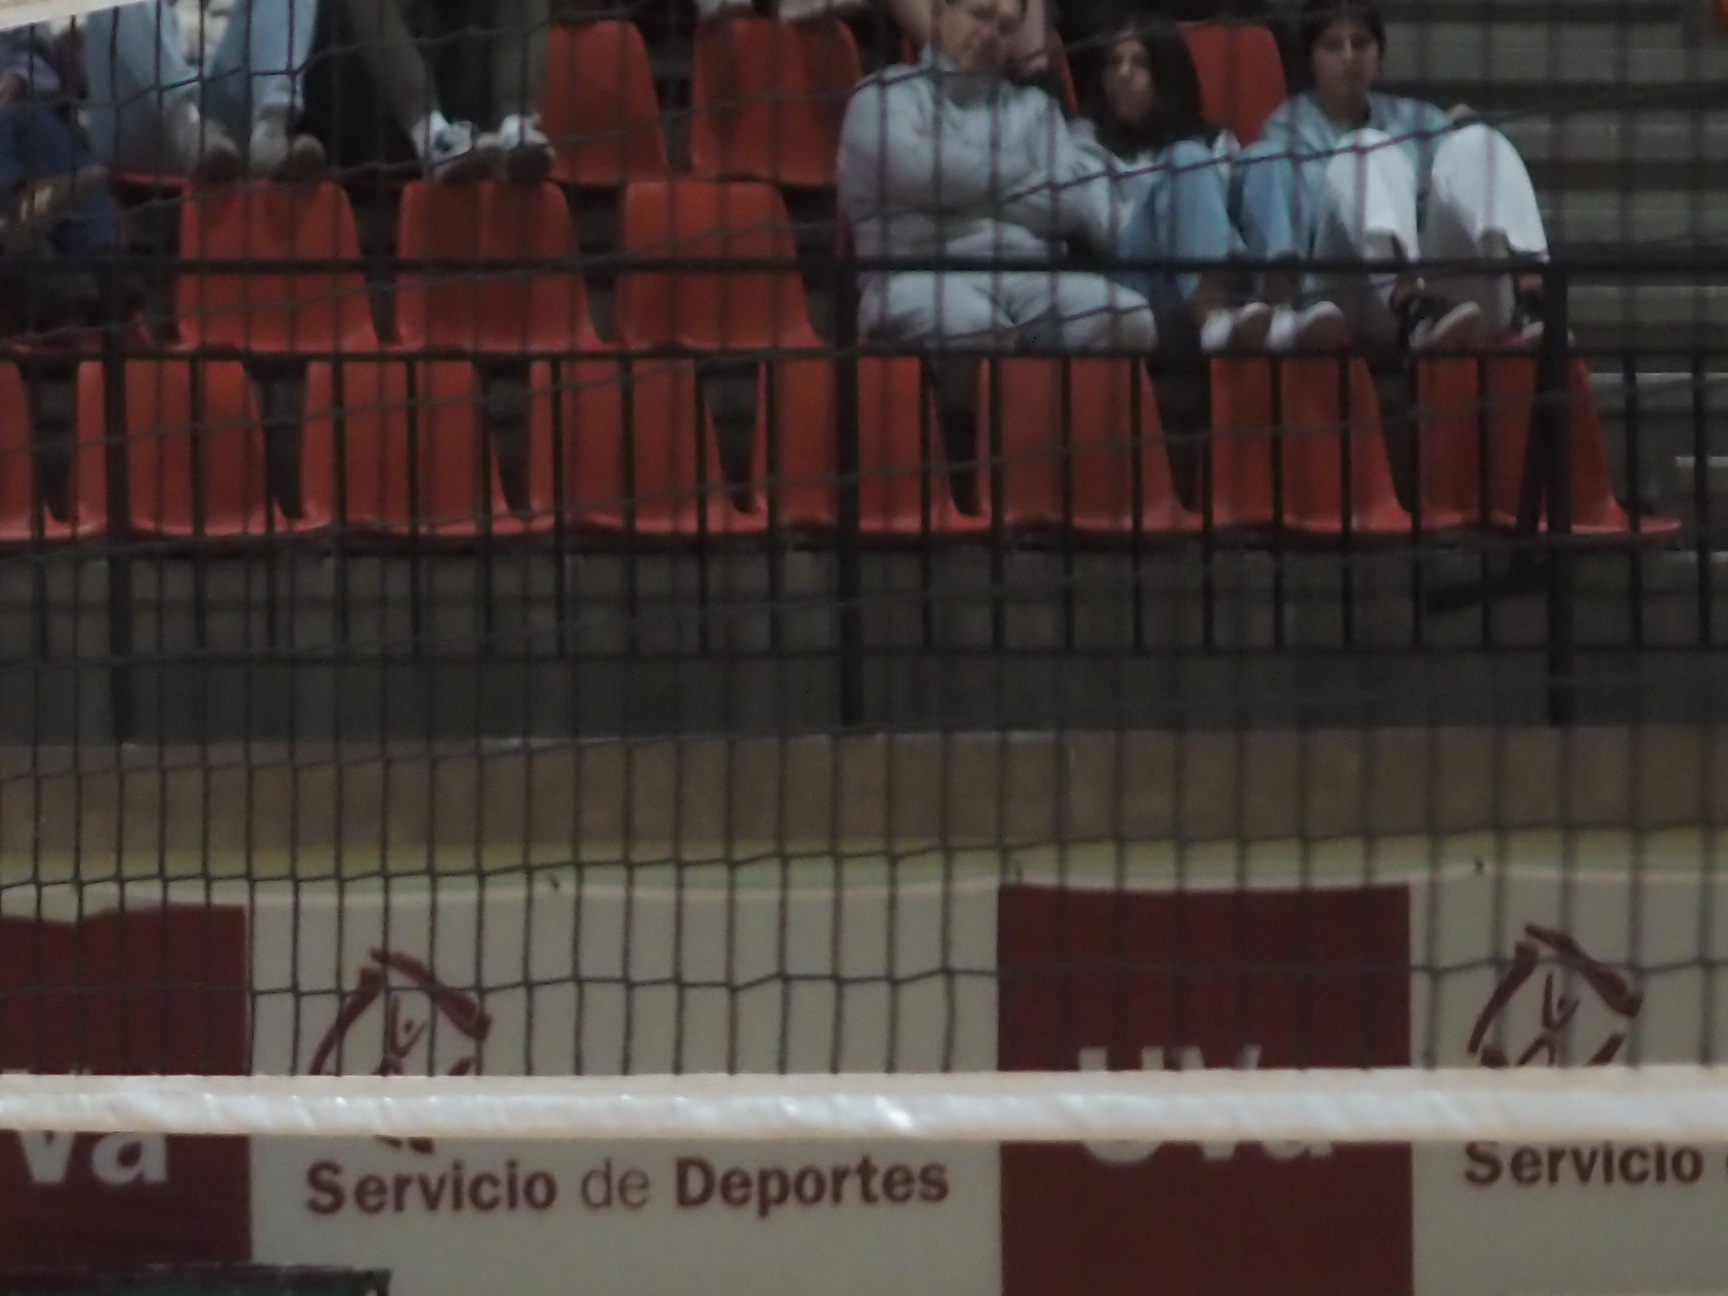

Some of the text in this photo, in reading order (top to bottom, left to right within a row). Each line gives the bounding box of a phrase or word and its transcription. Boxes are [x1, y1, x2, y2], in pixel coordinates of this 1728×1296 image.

[306, 1155, 950, 1218] Servicio de Deportes
[1465, 1141, 1704, 1185] Servicio
